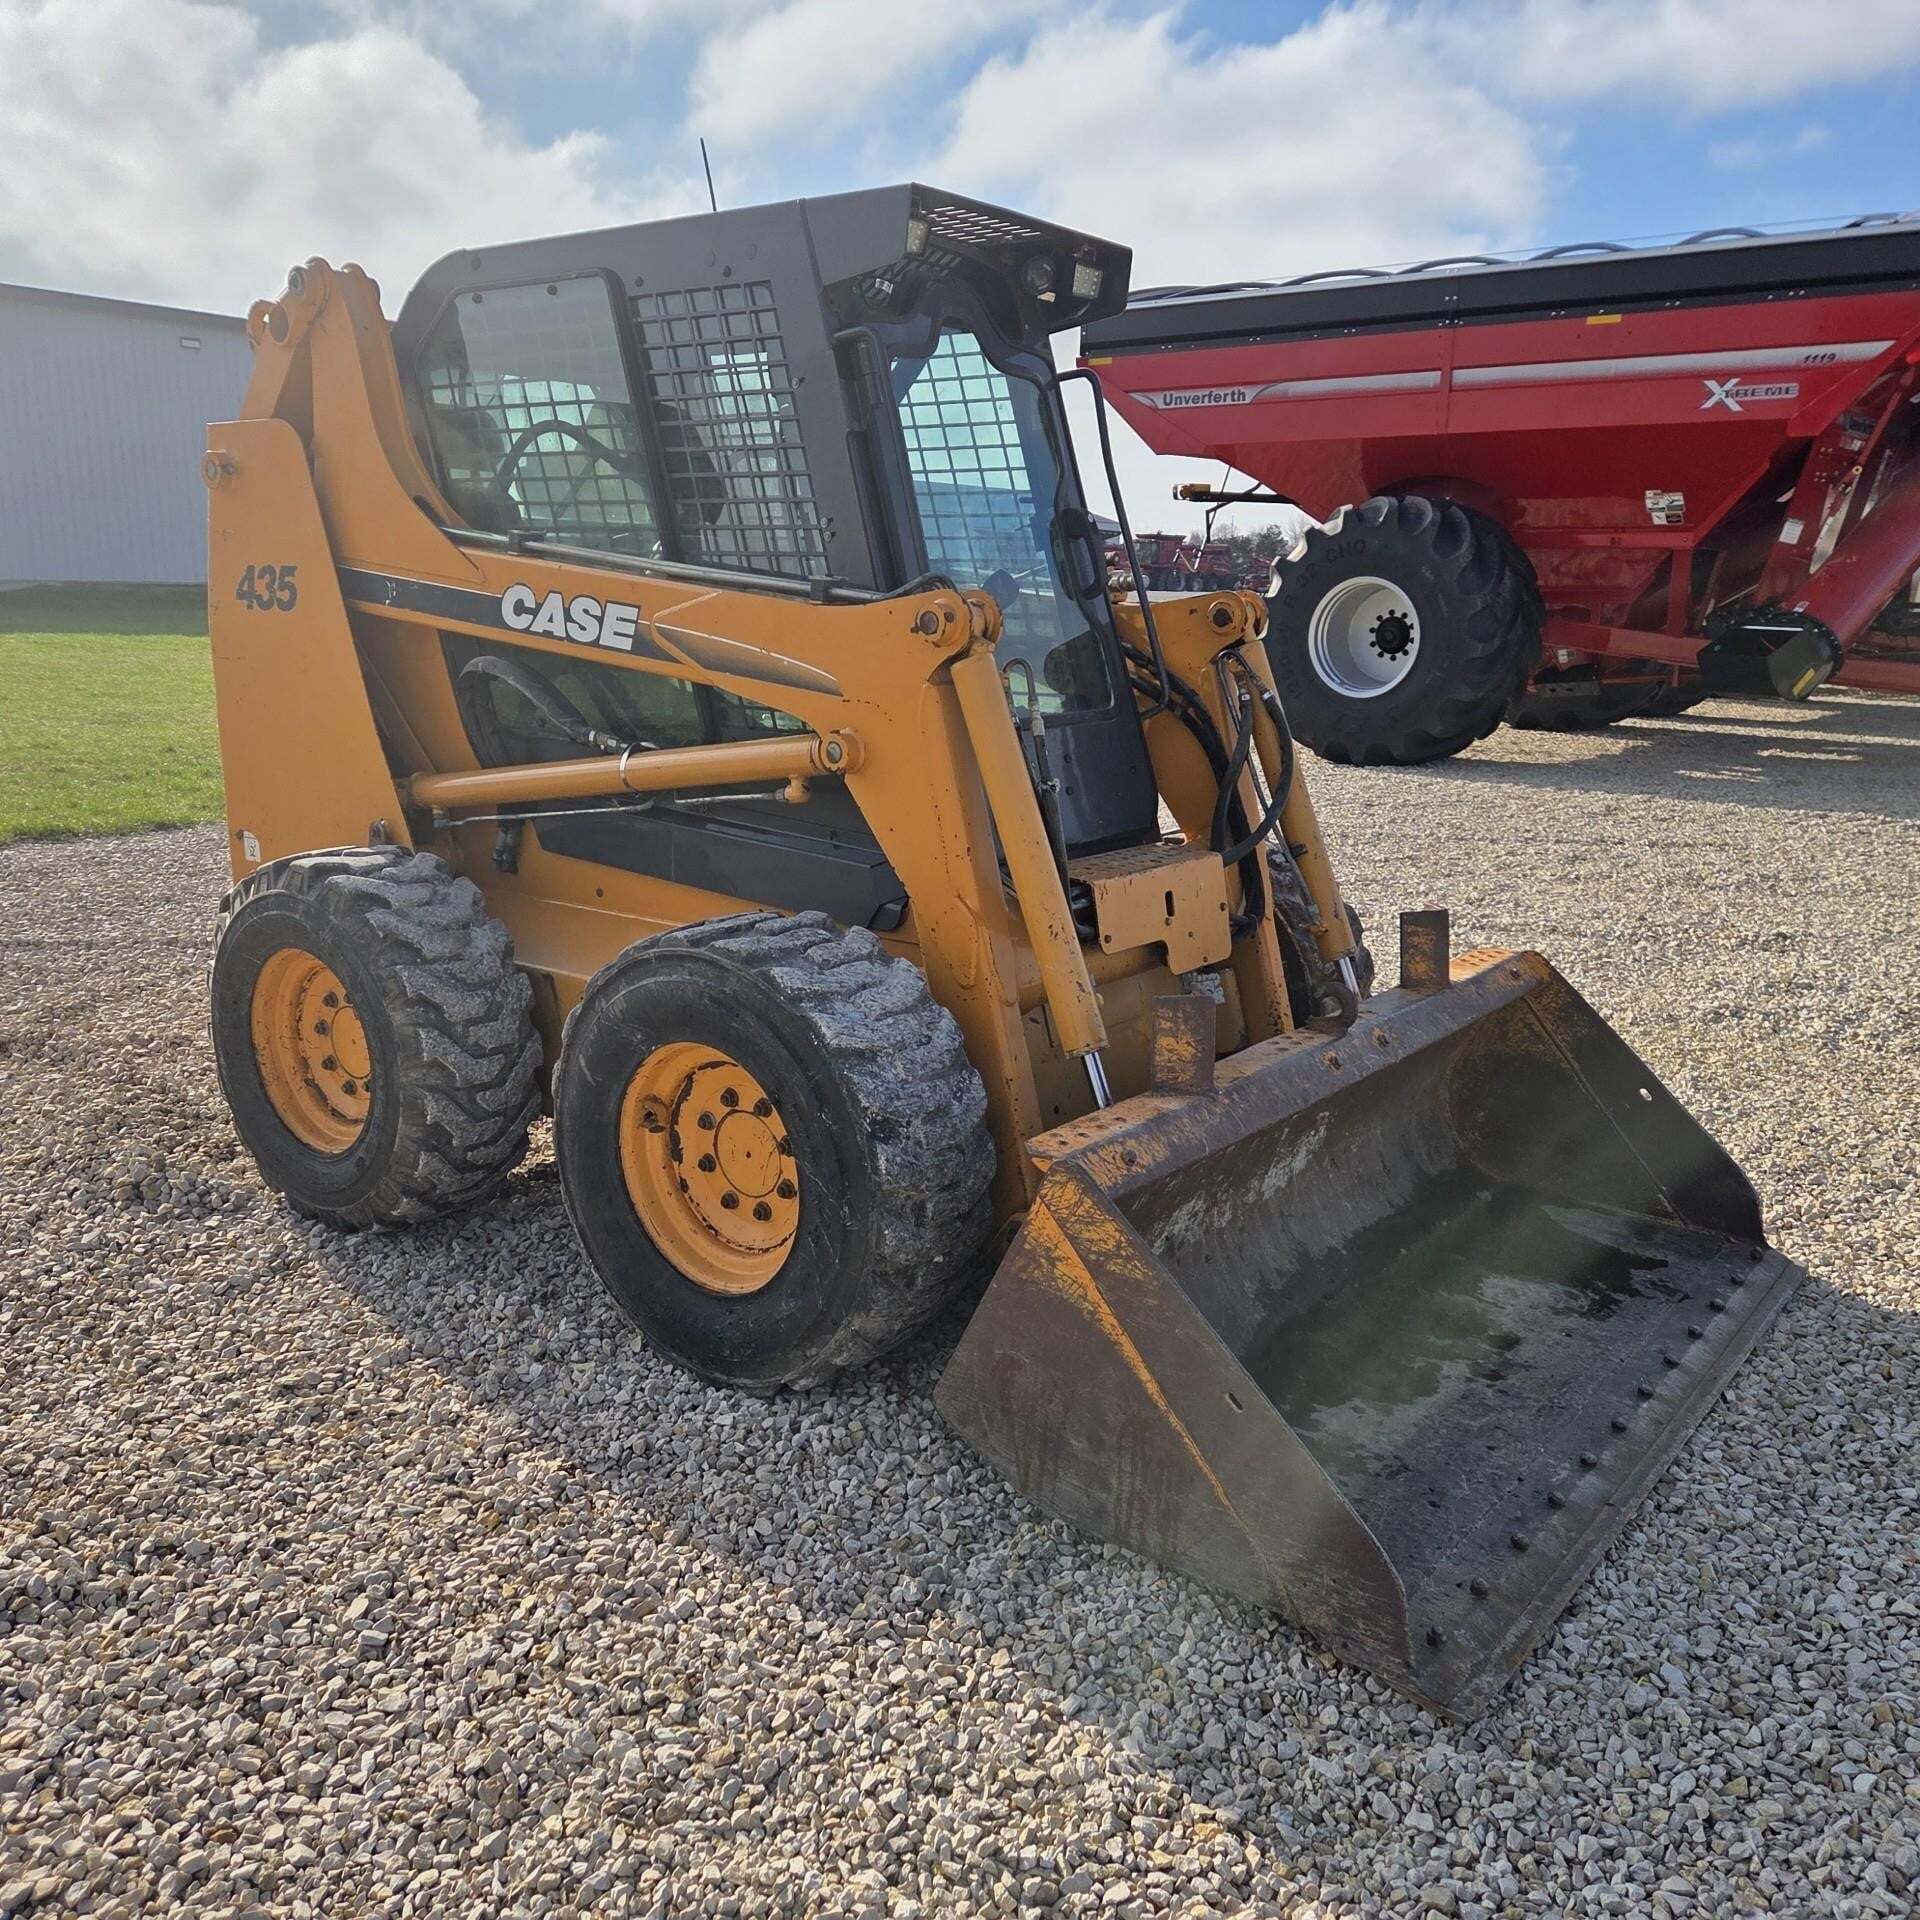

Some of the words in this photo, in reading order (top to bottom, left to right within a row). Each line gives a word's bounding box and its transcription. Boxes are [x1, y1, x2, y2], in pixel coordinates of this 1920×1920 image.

[1803, 352, 1837, 364] 1119
[1163, 389, 1246, 407] Unverferth
[1700, 377, 1799, 412] XTREME
[235, 564, 298, 611] 435
[501, 583, 639, 651] CASE
